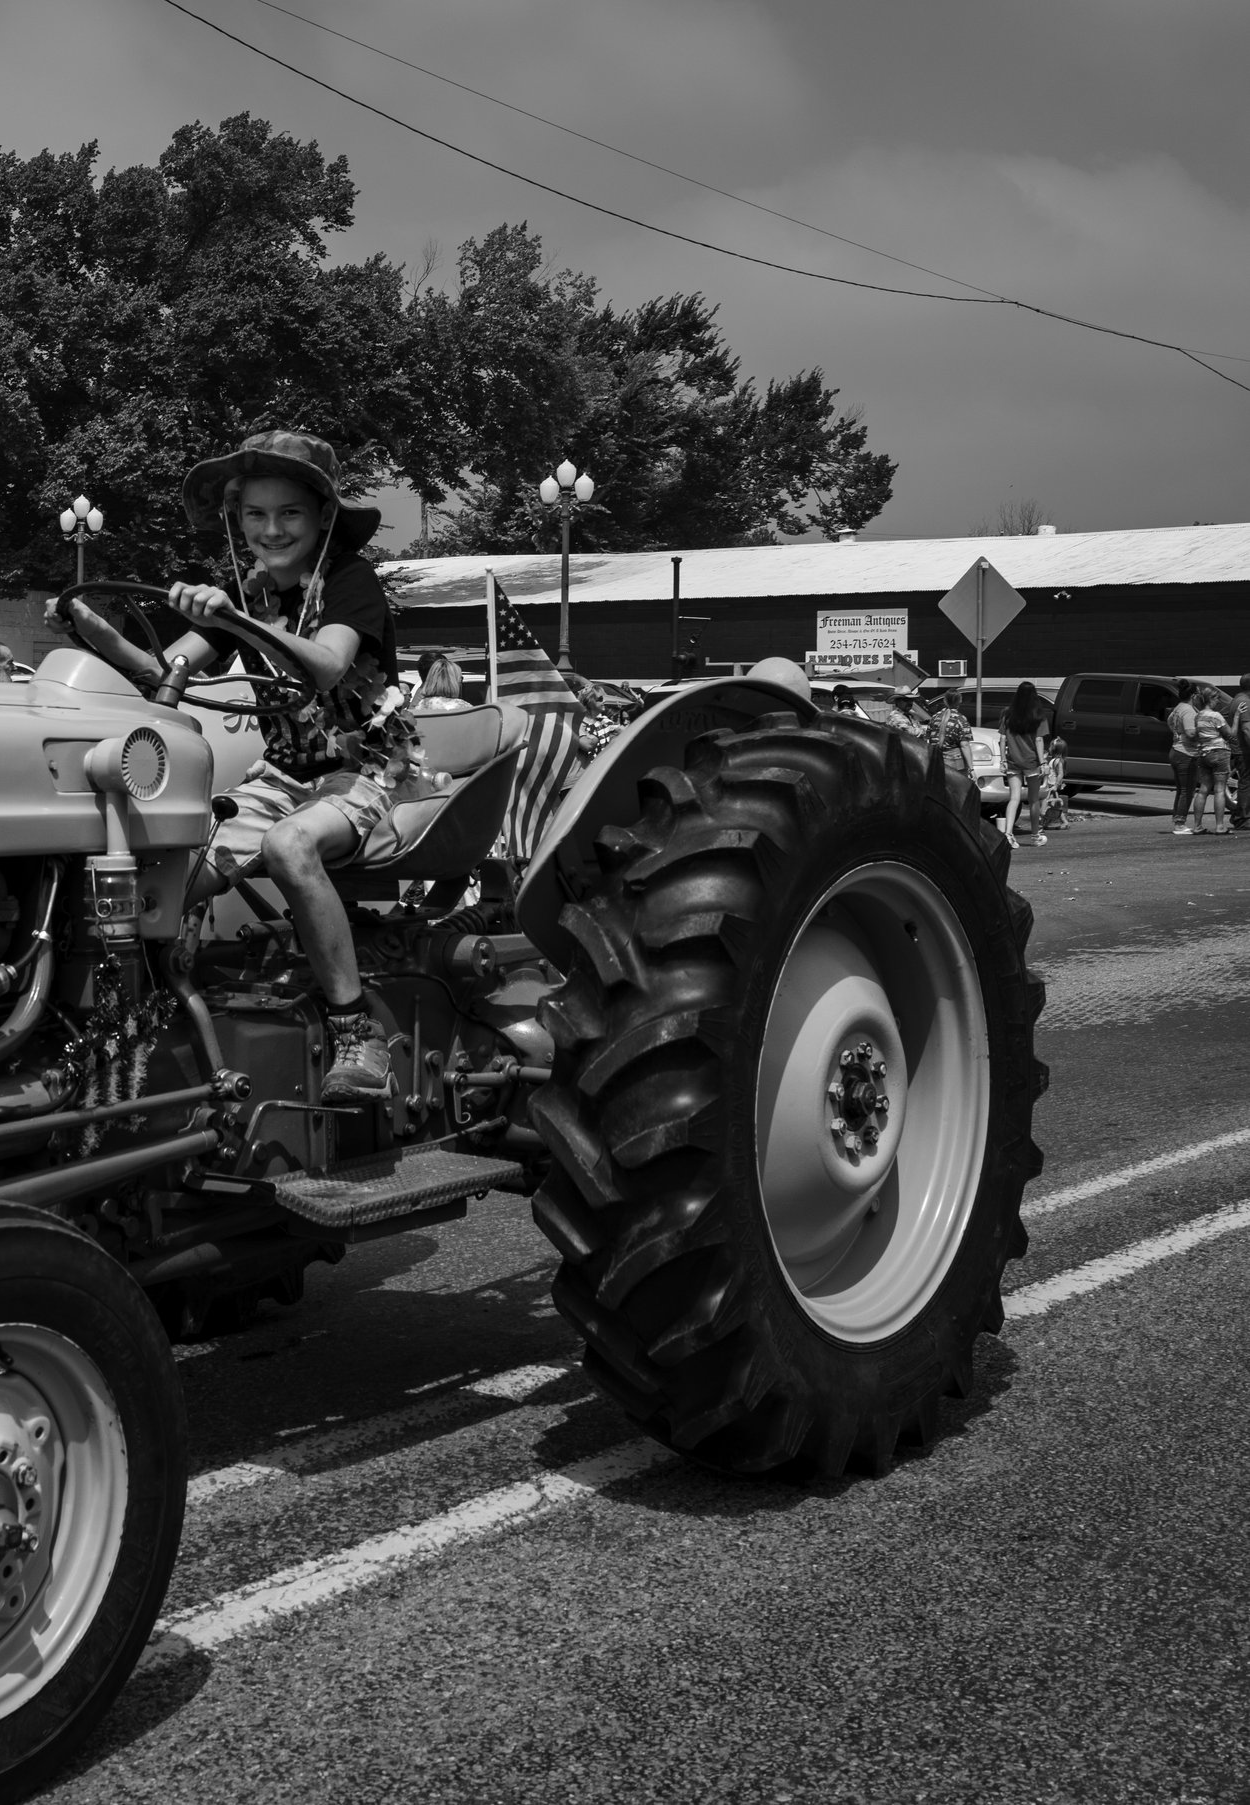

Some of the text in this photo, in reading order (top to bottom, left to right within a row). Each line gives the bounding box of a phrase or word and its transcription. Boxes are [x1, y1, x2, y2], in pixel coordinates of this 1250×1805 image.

[819, 615, 906, 629] Freeman Antiques
[830, 638, 896, 649] 254-715-7624
[809, 654, 879, 667] ANTIQUES
